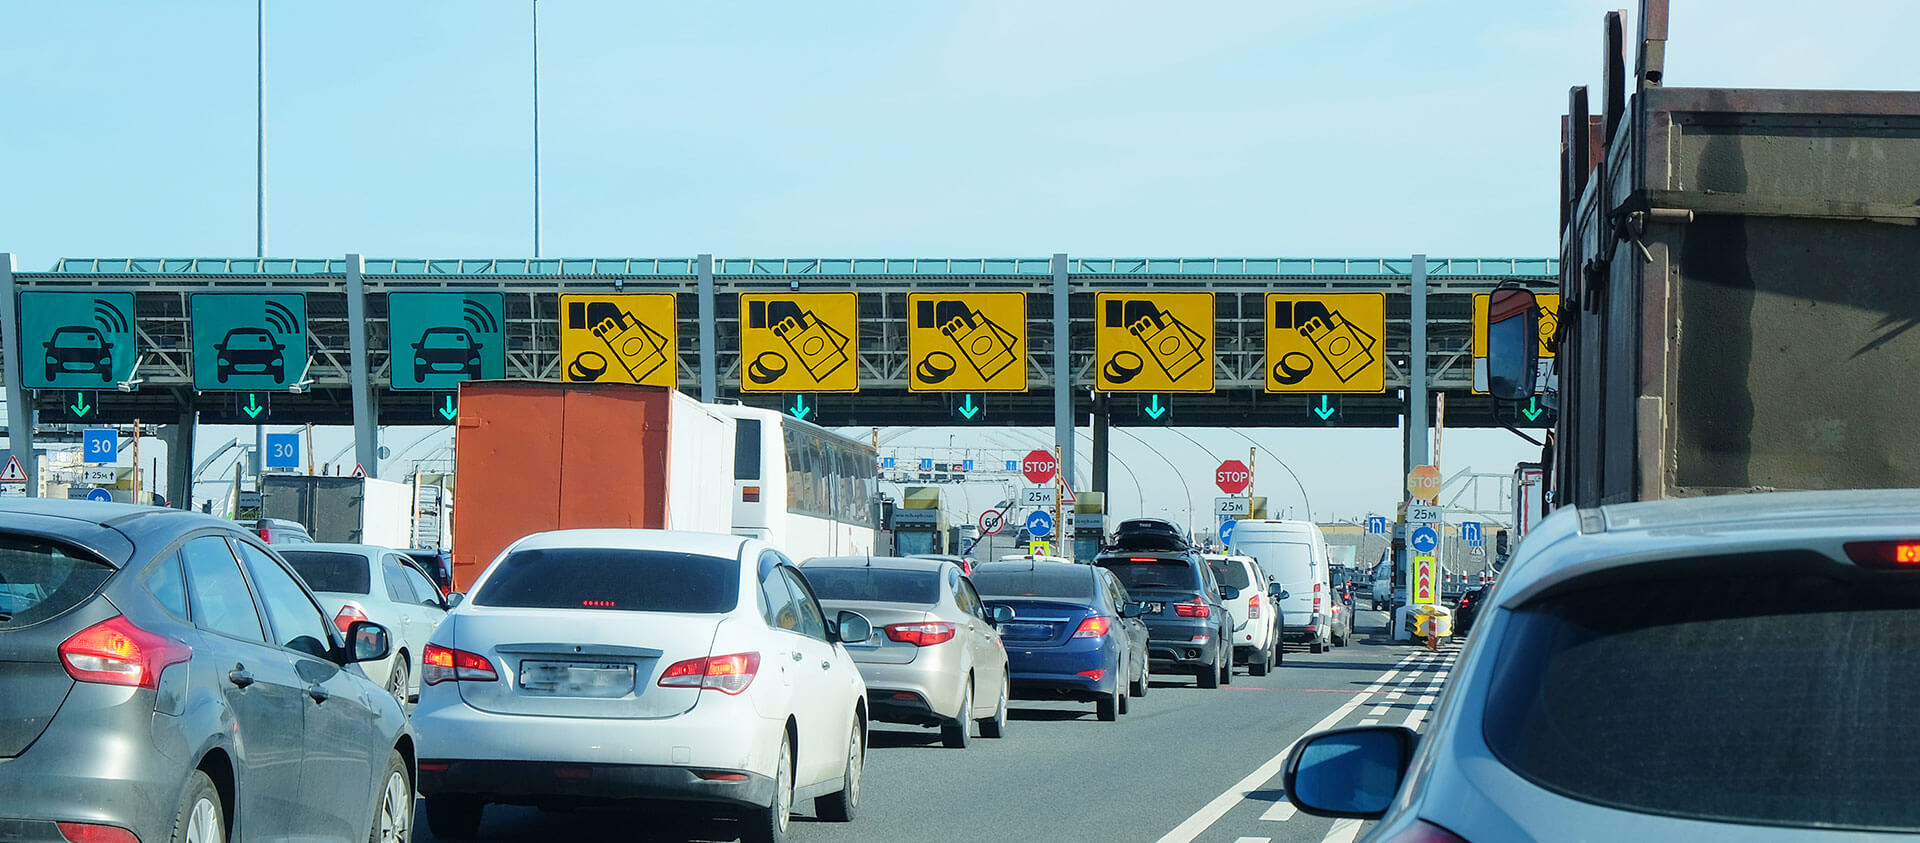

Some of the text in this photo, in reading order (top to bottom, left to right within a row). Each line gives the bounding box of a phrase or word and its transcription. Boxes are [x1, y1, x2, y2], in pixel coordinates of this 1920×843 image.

[91, 439, 111, 453] 30
[274, 443, 294, 458] 30
[1024, 461, 1055, 473] STOP
[1217, 471, 1248, 483] STOP
[1409, 477, 1441, 488] STOP
[985, 517, 998, 527] 60
